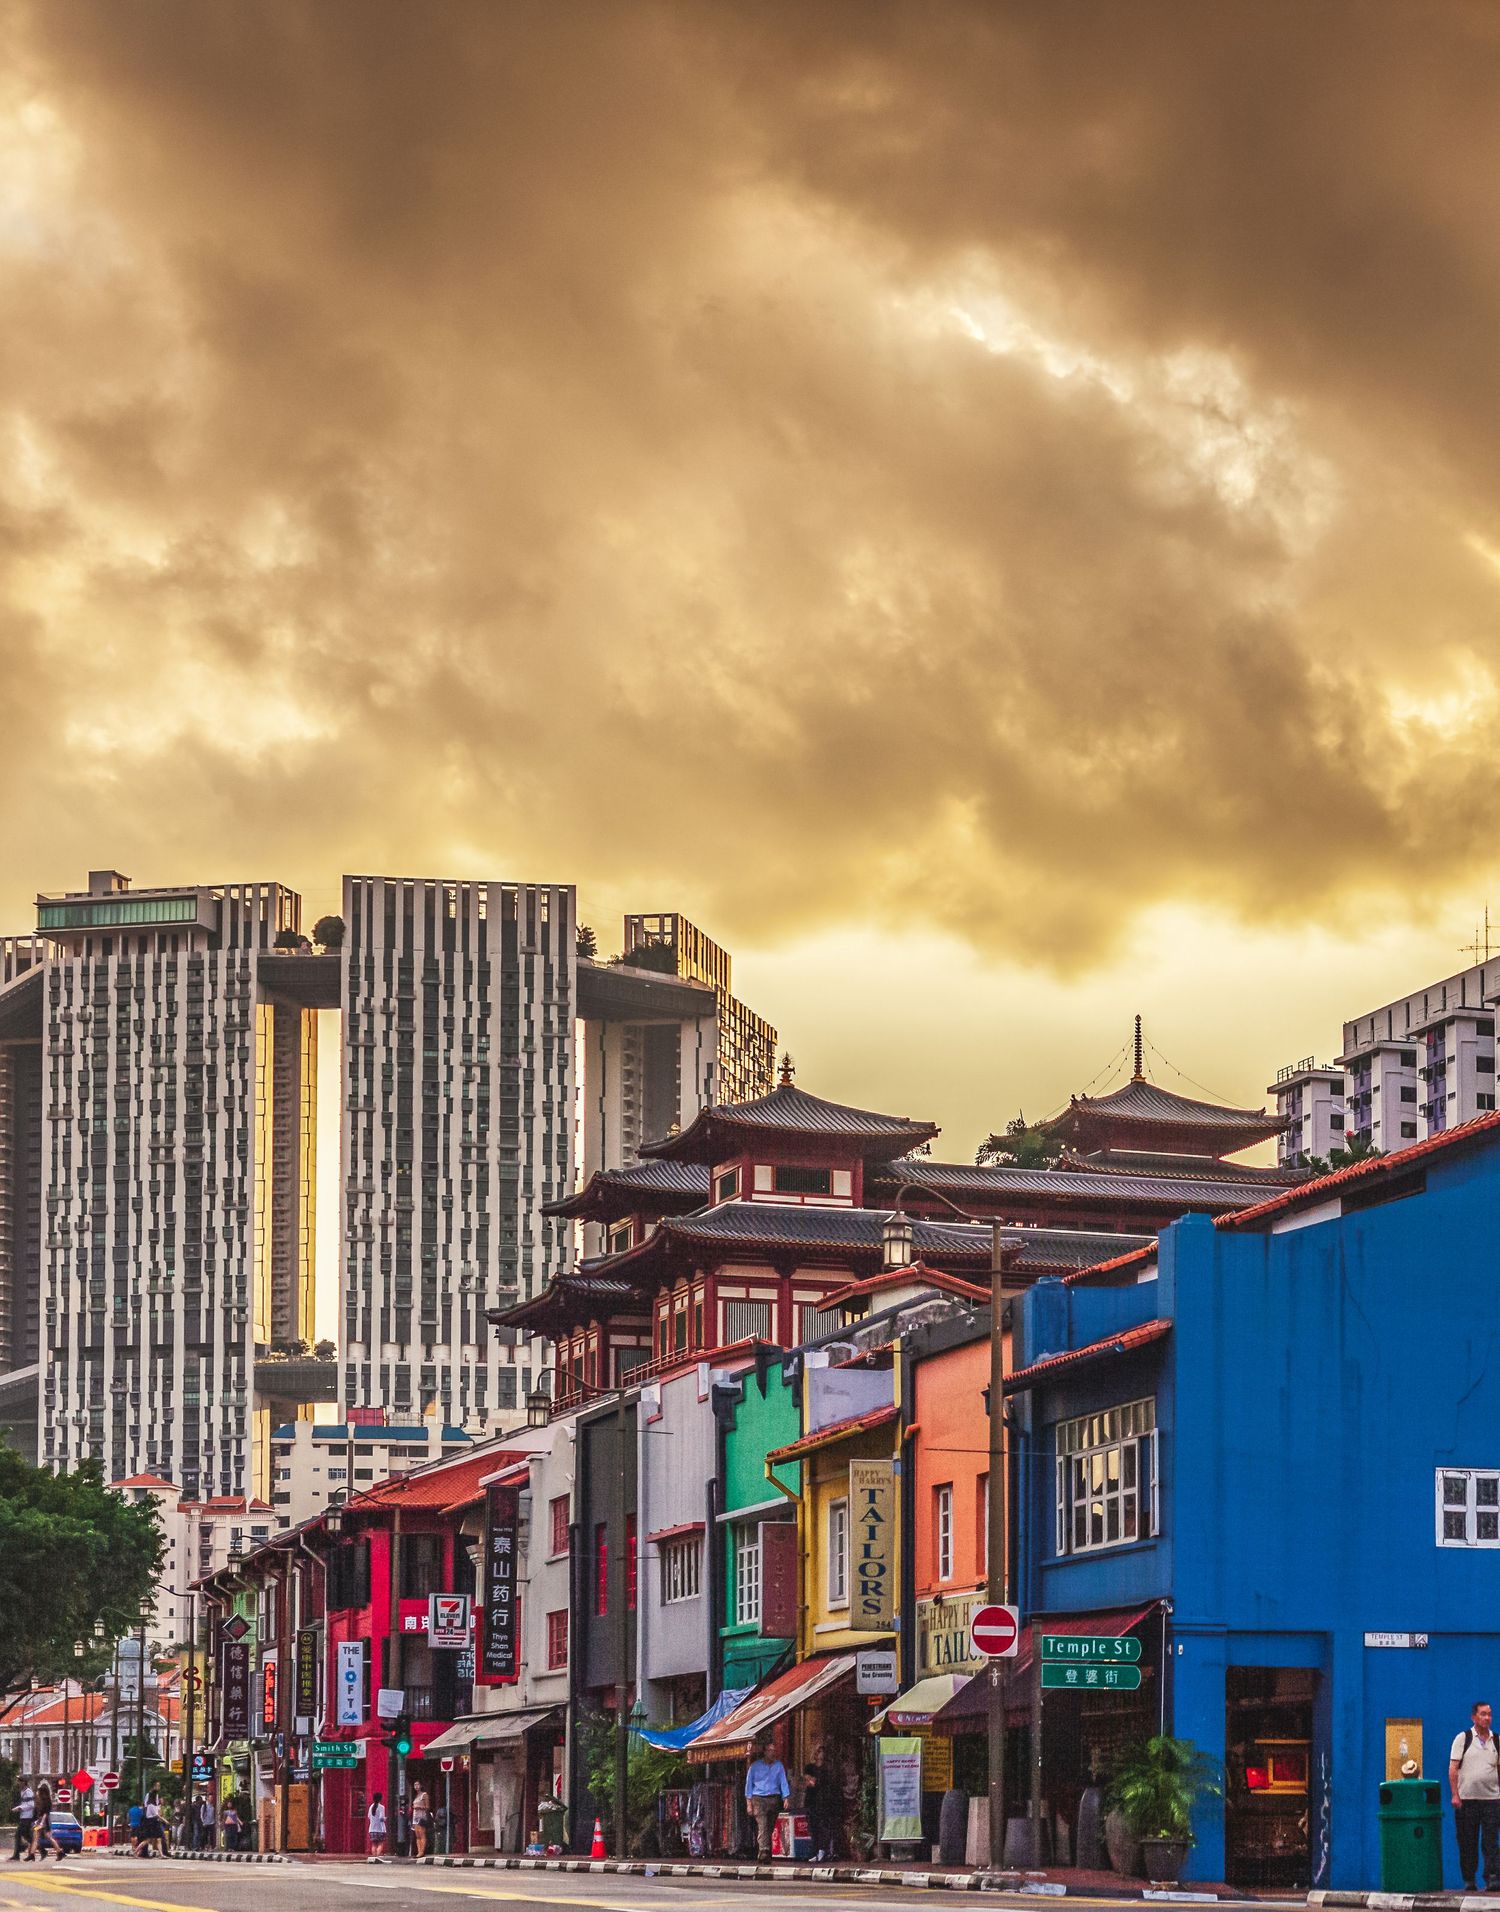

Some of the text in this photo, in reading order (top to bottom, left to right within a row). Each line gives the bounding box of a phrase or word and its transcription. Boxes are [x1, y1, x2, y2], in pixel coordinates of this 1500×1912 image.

[858, 1488, 886, 1615] TAILORS
[492, 1537, 511, 1626] 泰山药行
[930, 1604, 959, 1631] HAPPY
[492, 1633, 508, 1642] Thye
[342, 1646, 360, 1655] THE
[1047, 1638, 1131, 1657] Temple St
[345, 1658, 356, 1709] LOFT
[1065, 1669, 1118, 1684] 登婆街
[342, 1711, 358, 1721] Cafe
[315, 1744, 341, 1752] Smith
[343, 1744, 353, 1752] St
